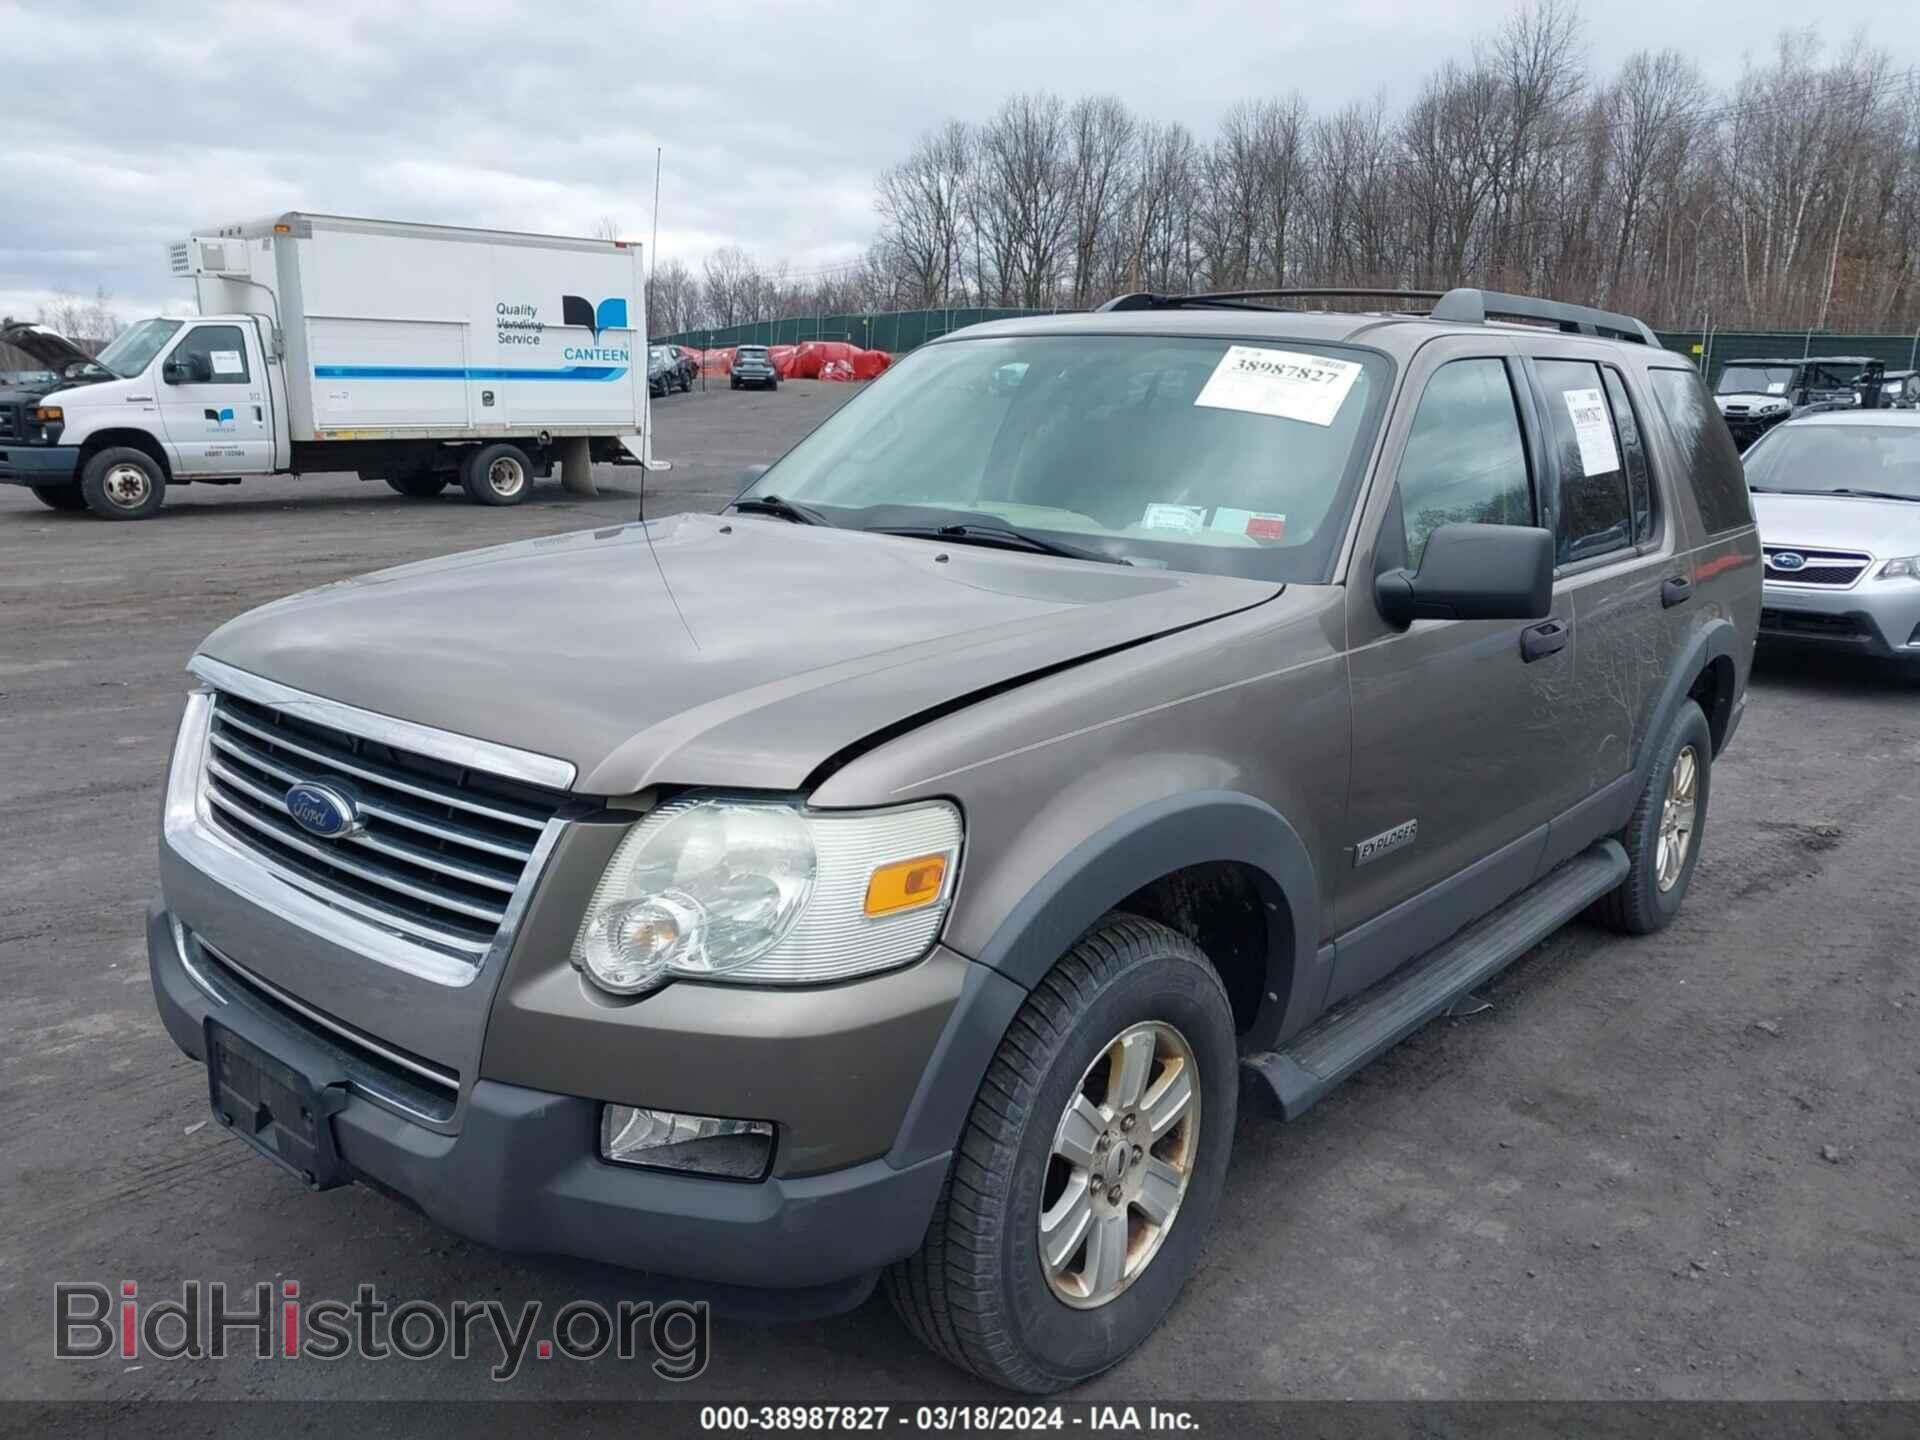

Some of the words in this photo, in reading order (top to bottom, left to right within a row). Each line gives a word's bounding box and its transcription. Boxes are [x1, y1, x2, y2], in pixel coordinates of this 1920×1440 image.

[496, 302, 538, 319] Quality
[496, 317, 545, 334] Vending
[497, 332, 540, 345] Service
[563, 347, 629, 361] CANTEEN
[1232, 358, 1340, 385] 38987827
[293, 791, 330, 827] Ford
[1359, 822, 1417, 858] EXPLORER
